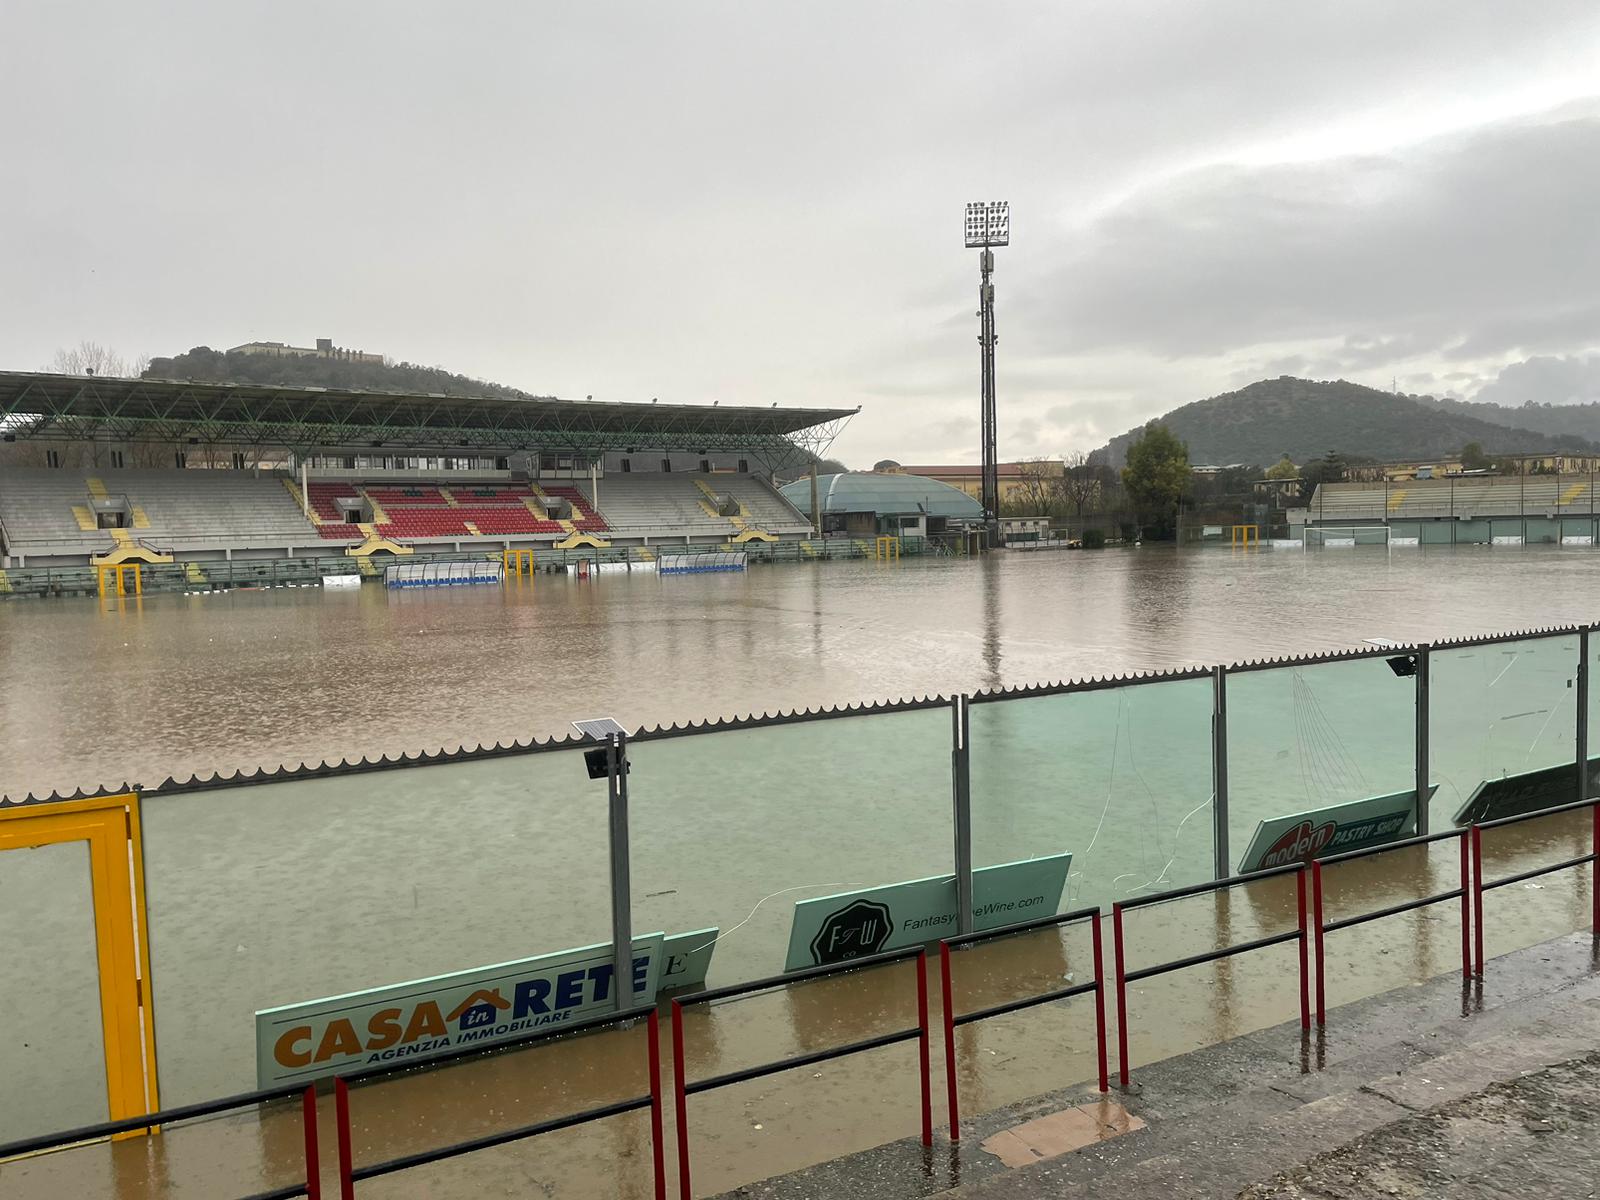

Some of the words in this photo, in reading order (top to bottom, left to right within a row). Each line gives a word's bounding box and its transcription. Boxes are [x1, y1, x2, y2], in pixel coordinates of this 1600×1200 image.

[1265, 825, 1326, 867] modern
[1330, 823, 1376, 846] PASTRY
[1375, 817, 1404, 836] SHOP
[903, 895, 1044, 931] FantasyeWine.com
[274, 1000, 448, 1068] CASA
[466, 1010, 490, 1027] in
[512, 956, 650, 1020] RETE
[366, 1036, 452, 1065] AGENZIA
[456, 1010, 572, 1045] IMMOBILIARE
